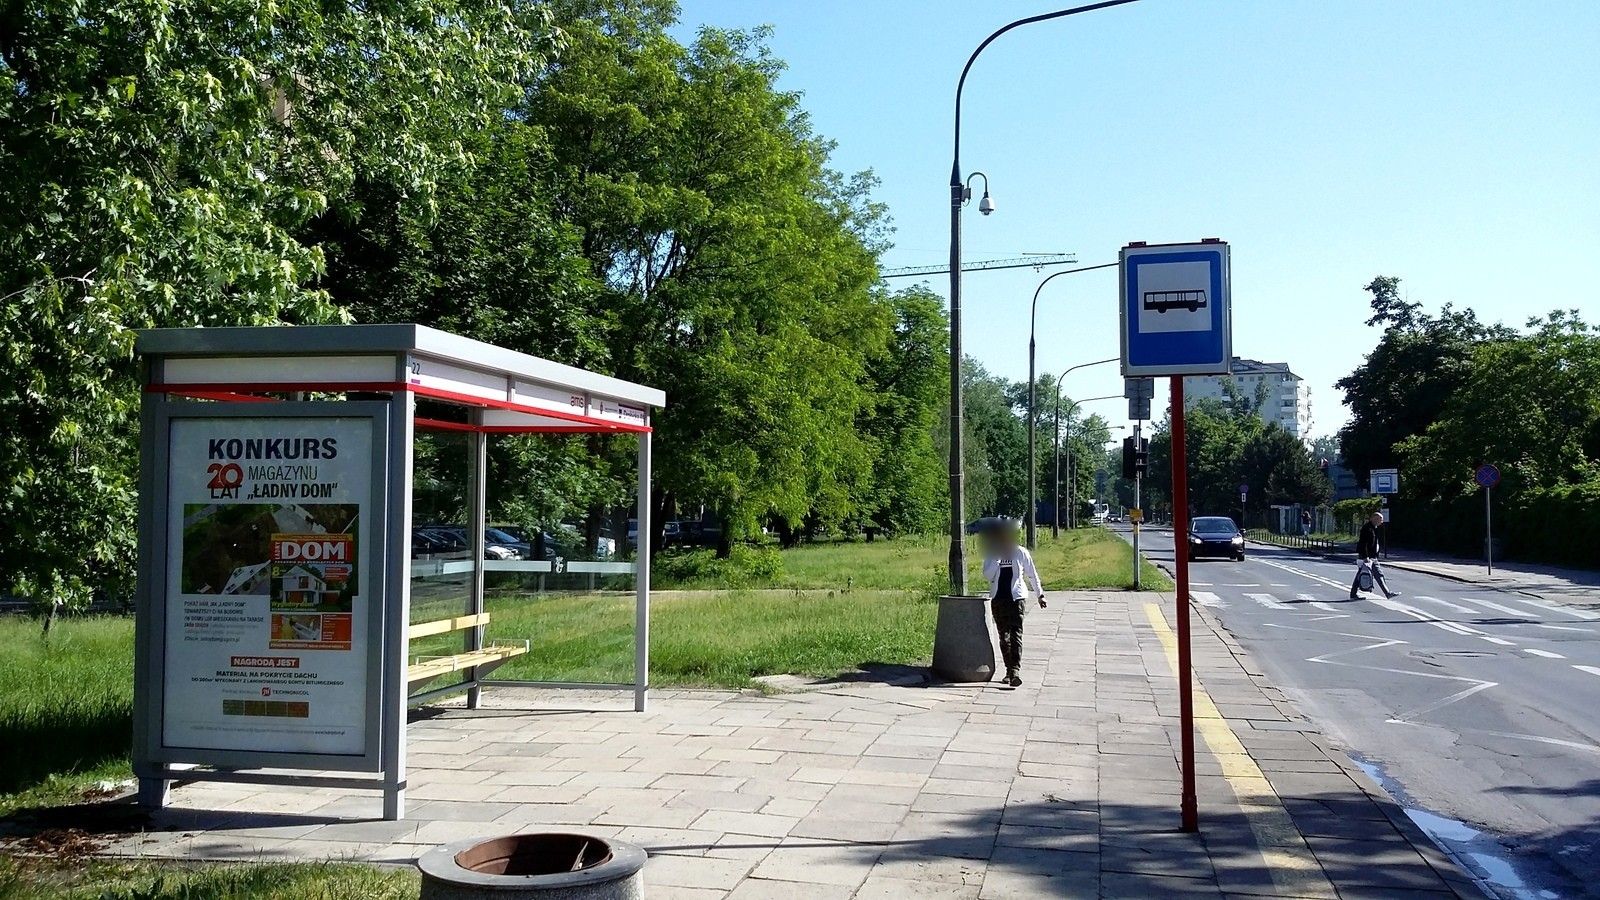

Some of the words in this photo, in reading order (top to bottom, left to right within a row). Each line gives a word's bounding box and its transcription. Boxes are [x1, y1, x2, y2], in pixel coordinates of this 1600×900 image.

[411, 362, 421, 376] 22
[570, 396, 584, 409] ams
[208, 437, 338, 460] KONKURS
[206, 463, 244, 489] 20
[248, 465, 318, 481] MAGAZYNU
[210, 485, 243, 499] LAT
[281, 541, 345, 560] DOM
[272, 566, 280, 577] 8
[233, 658, 275, 668] NAGRODĄ
[276, 659, 297, 667] JEST
